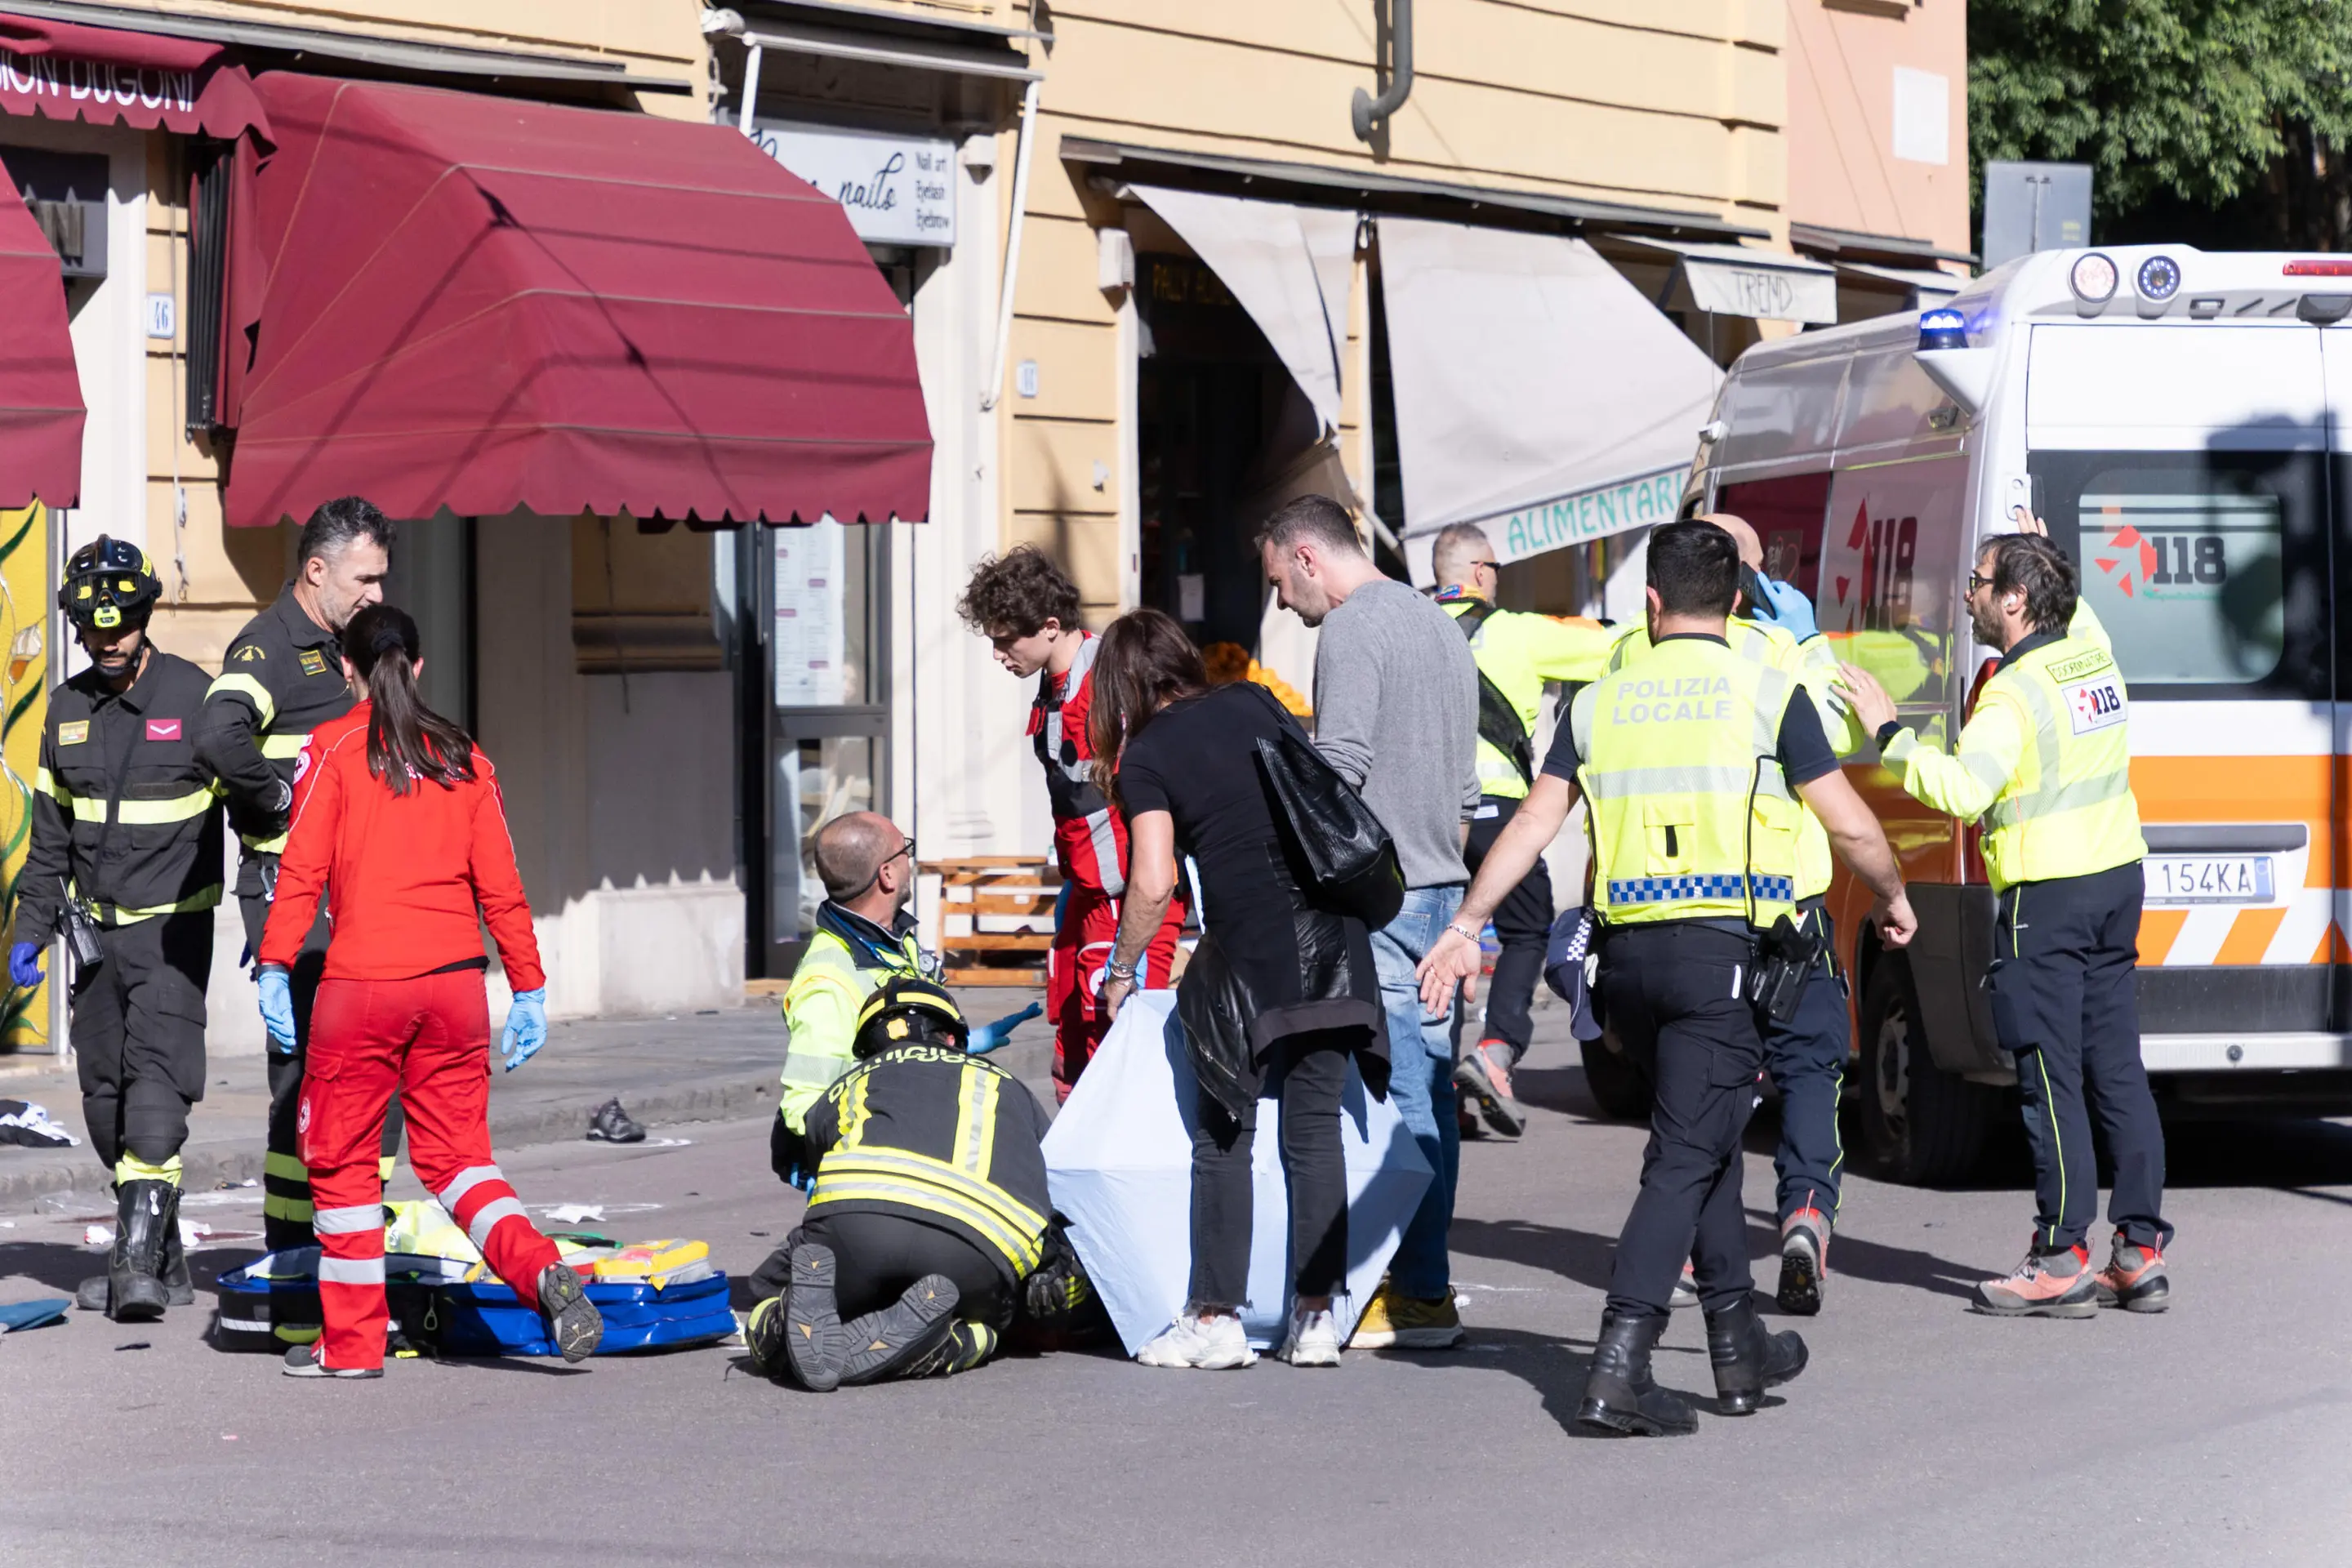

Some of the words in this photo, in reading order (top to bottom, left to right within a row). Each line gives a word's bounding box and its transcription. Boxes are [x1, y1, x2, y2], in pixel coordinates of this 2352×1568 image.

[0, 49, 58, 96] ION
[69, 59, 193, 113] DUGONI
[839, 152, 906, 211] nails
[1731, 270, 1793, 317] TREND
[1508, 472, 1682, 555] ALIMENTARI
[1864, 516, 1918, 631] 118
[2151, 536, 2227, 585] 118
[1612, 700, 1733, 725] LOCALE
[1617, 676, 1731, 701] POLIZIA
[2091, 685, 2121, 715] 118
[828, 1062, 880, 1104] DEL
